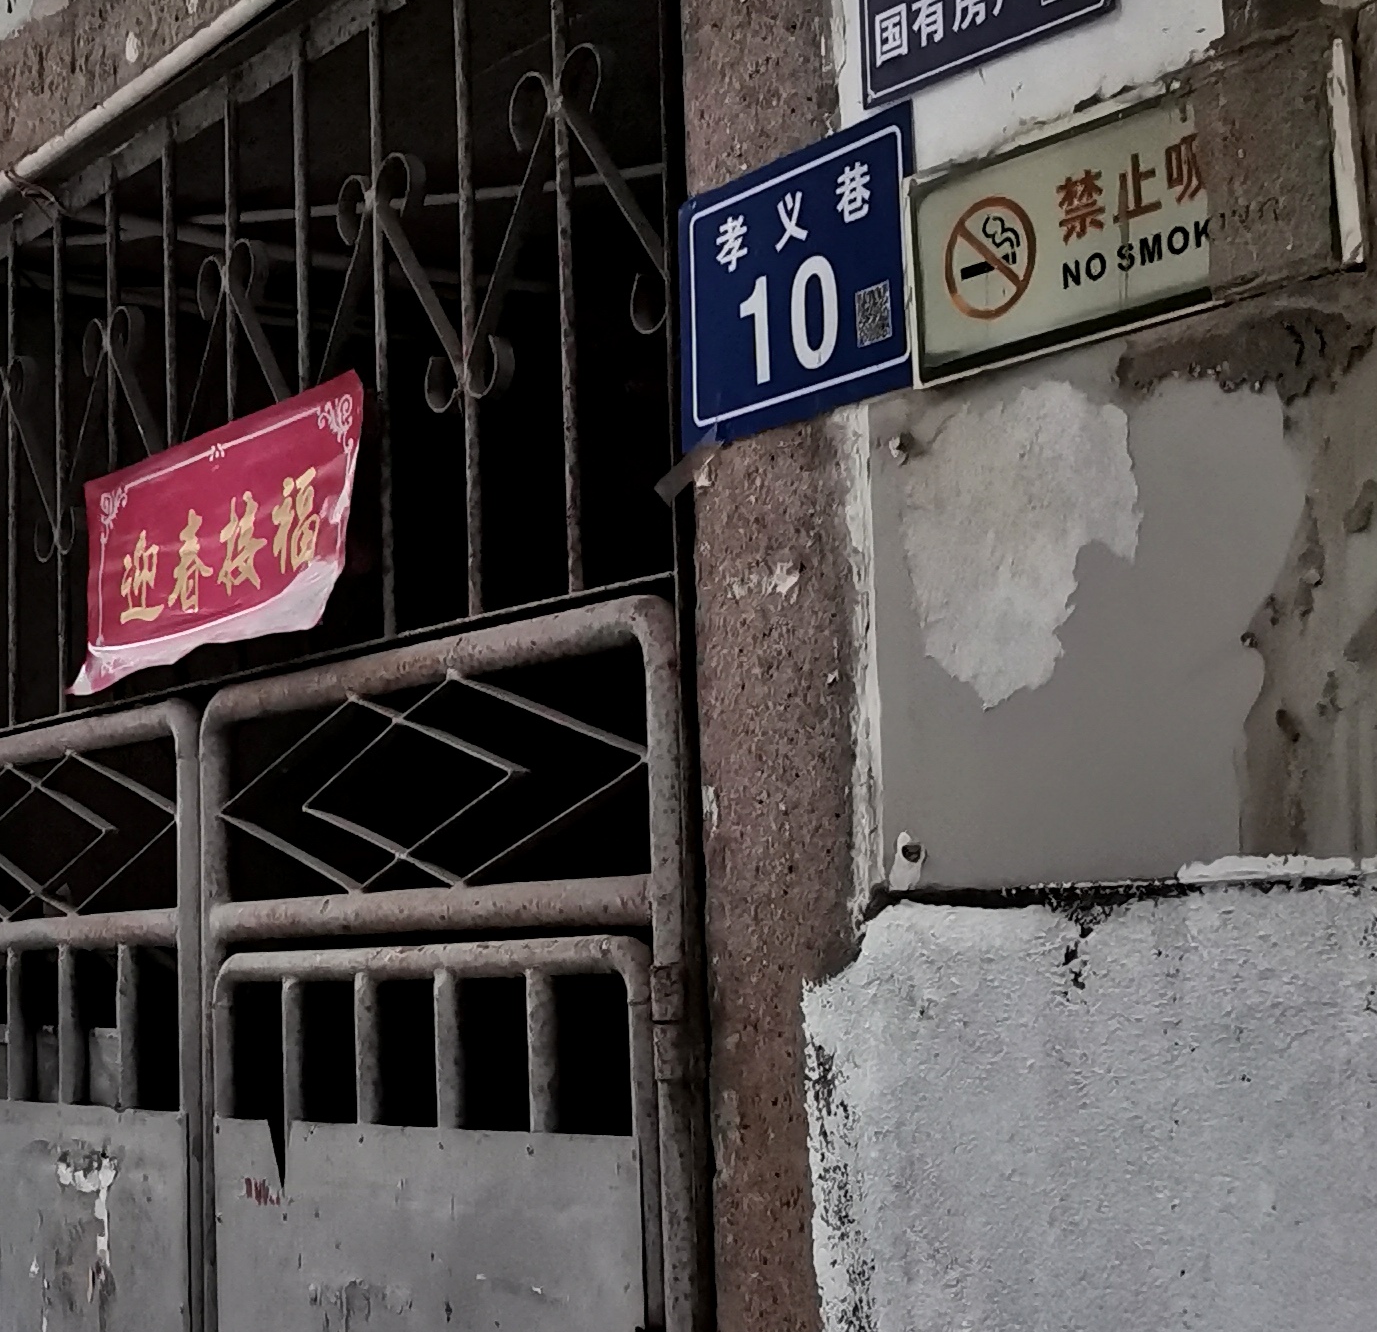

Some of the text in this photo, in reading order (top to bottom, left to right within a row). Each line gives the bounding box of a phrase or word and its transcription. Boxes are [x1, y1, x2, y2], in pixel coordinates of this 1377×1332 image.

[715, 161, 872, 273] 孝义巷
[1055, 132, 1206, 246] 禁止吸
[739, 255, 839, 386] 10
[1061, 252, 1107, 290] NO
